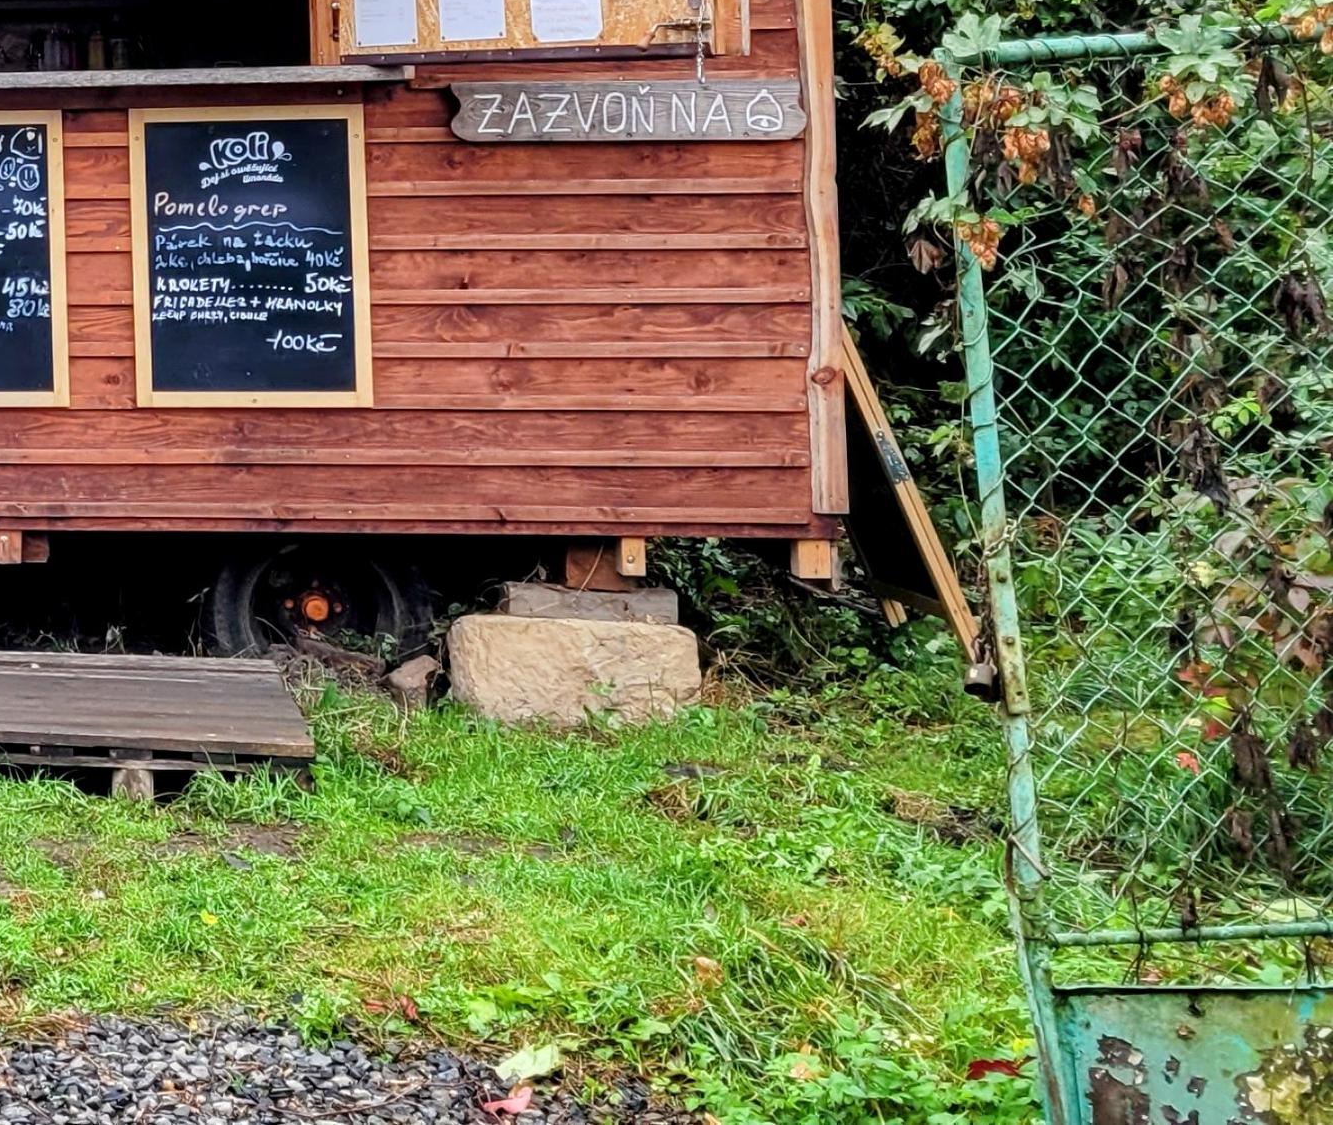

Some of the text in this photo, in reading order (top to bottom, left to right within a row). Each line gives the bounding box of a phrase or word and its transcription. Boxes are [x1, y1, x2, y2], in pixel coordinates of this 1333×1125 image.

[472, 84, 733, 135] ZAZVOŇ NA
[209, 131, 270, 170] Koli
[153, 191, 229, 217] Pomelo
[155, 229, 314, 251] Párek na tácku
[156, 276, 231, 293] KROKETY
[304, 272, 353, 294] 50Kč
[264, 296, 343, 317] HRANOLKY
